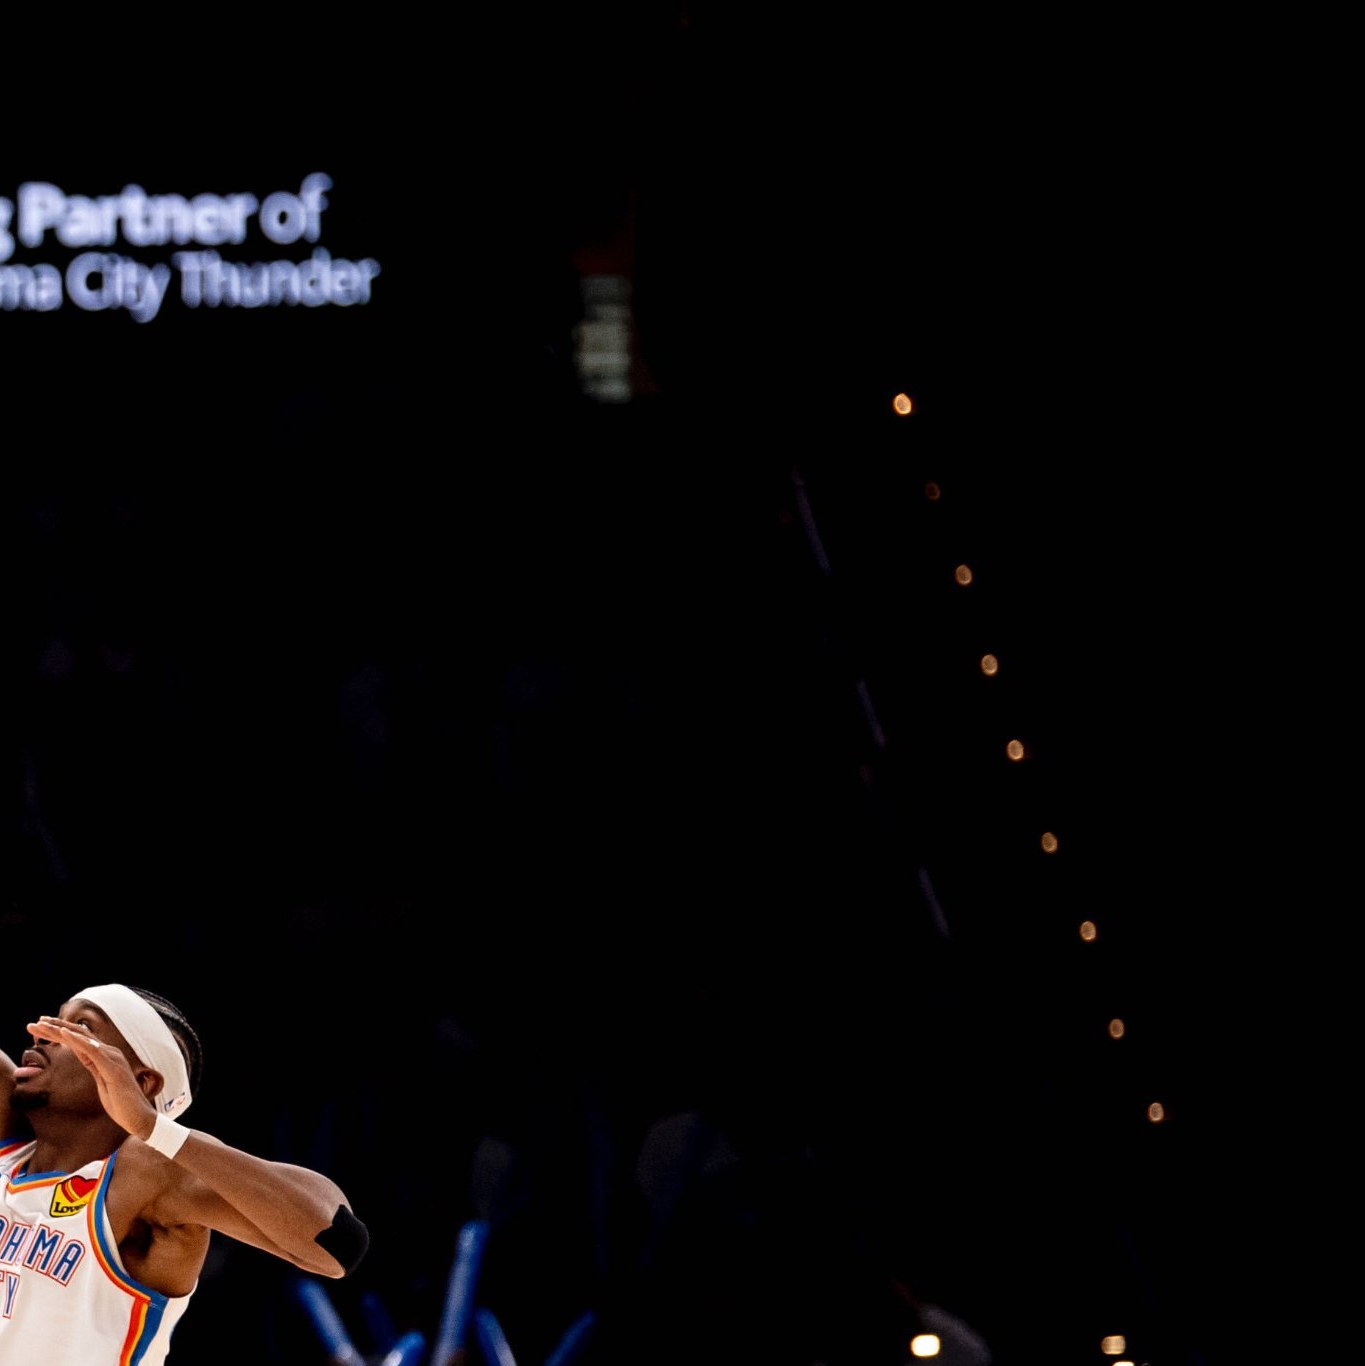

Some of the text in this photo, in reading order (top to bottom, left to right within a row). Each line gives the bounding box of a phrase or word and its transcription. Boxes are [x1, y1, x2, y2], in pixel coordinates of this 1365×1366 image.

[18, 183, 258, 247] Partner
[260, 173, 334, 244] of
[67, 252, 170, 323] City
[175, 248, 381, 307] Thunder
